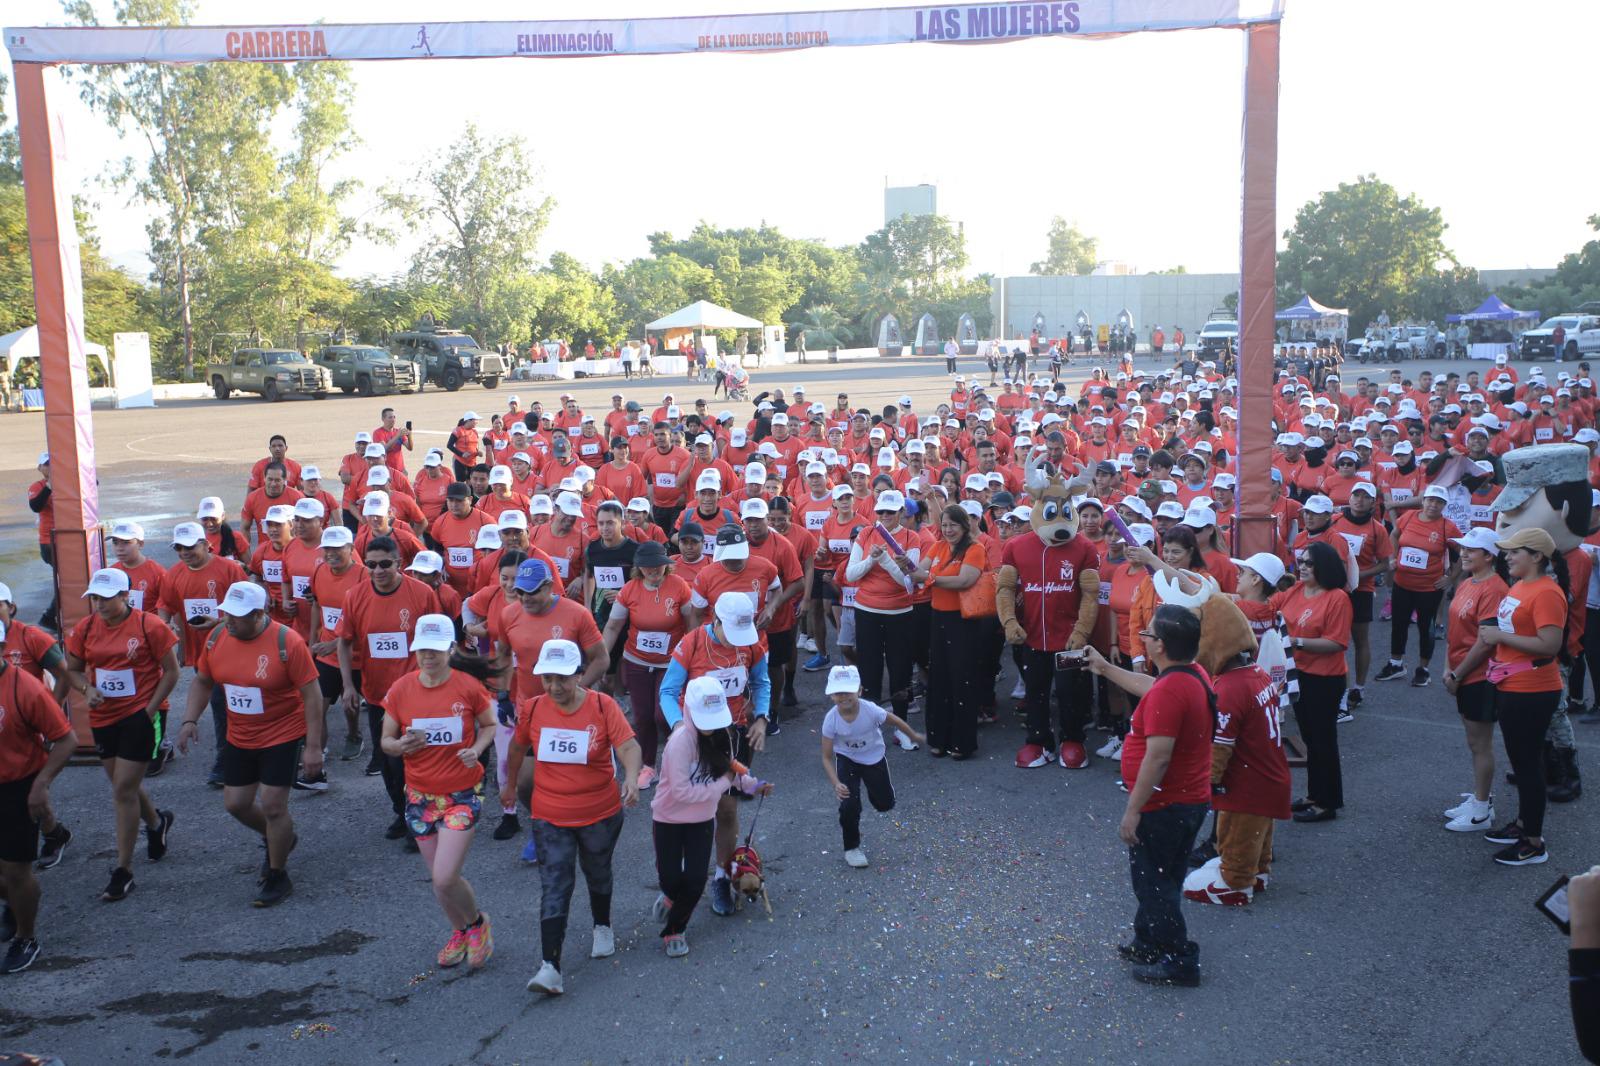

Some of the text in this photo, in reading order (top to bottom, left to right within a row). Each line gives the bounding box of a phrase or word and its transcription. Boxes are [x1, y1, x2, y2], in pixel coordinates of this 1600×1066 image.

[226, 2, 1081, 58] CARRERA ELIMINACIÓN DE LA VIOLENCIA CONTRA LAS MUJERES
[703, 542, 715, 551] 11
[1405, 554, 1422, 564] 162
[599, 574, 617, 583] 319
[1098, 590, 1109, 600] 26
[191, 606, 210, 615] 339
[327, 614, 339, 624] 27
[375, 641, 399, 651] 238
[642, 638, 663, 649] 253
[100, 681, 125, 691] 433
[719, 677, 739, 690] 71
[230, 696, 252, 709] 317
[425, 732, 453, 744] 240
[549, 740, 577, 754] 156
